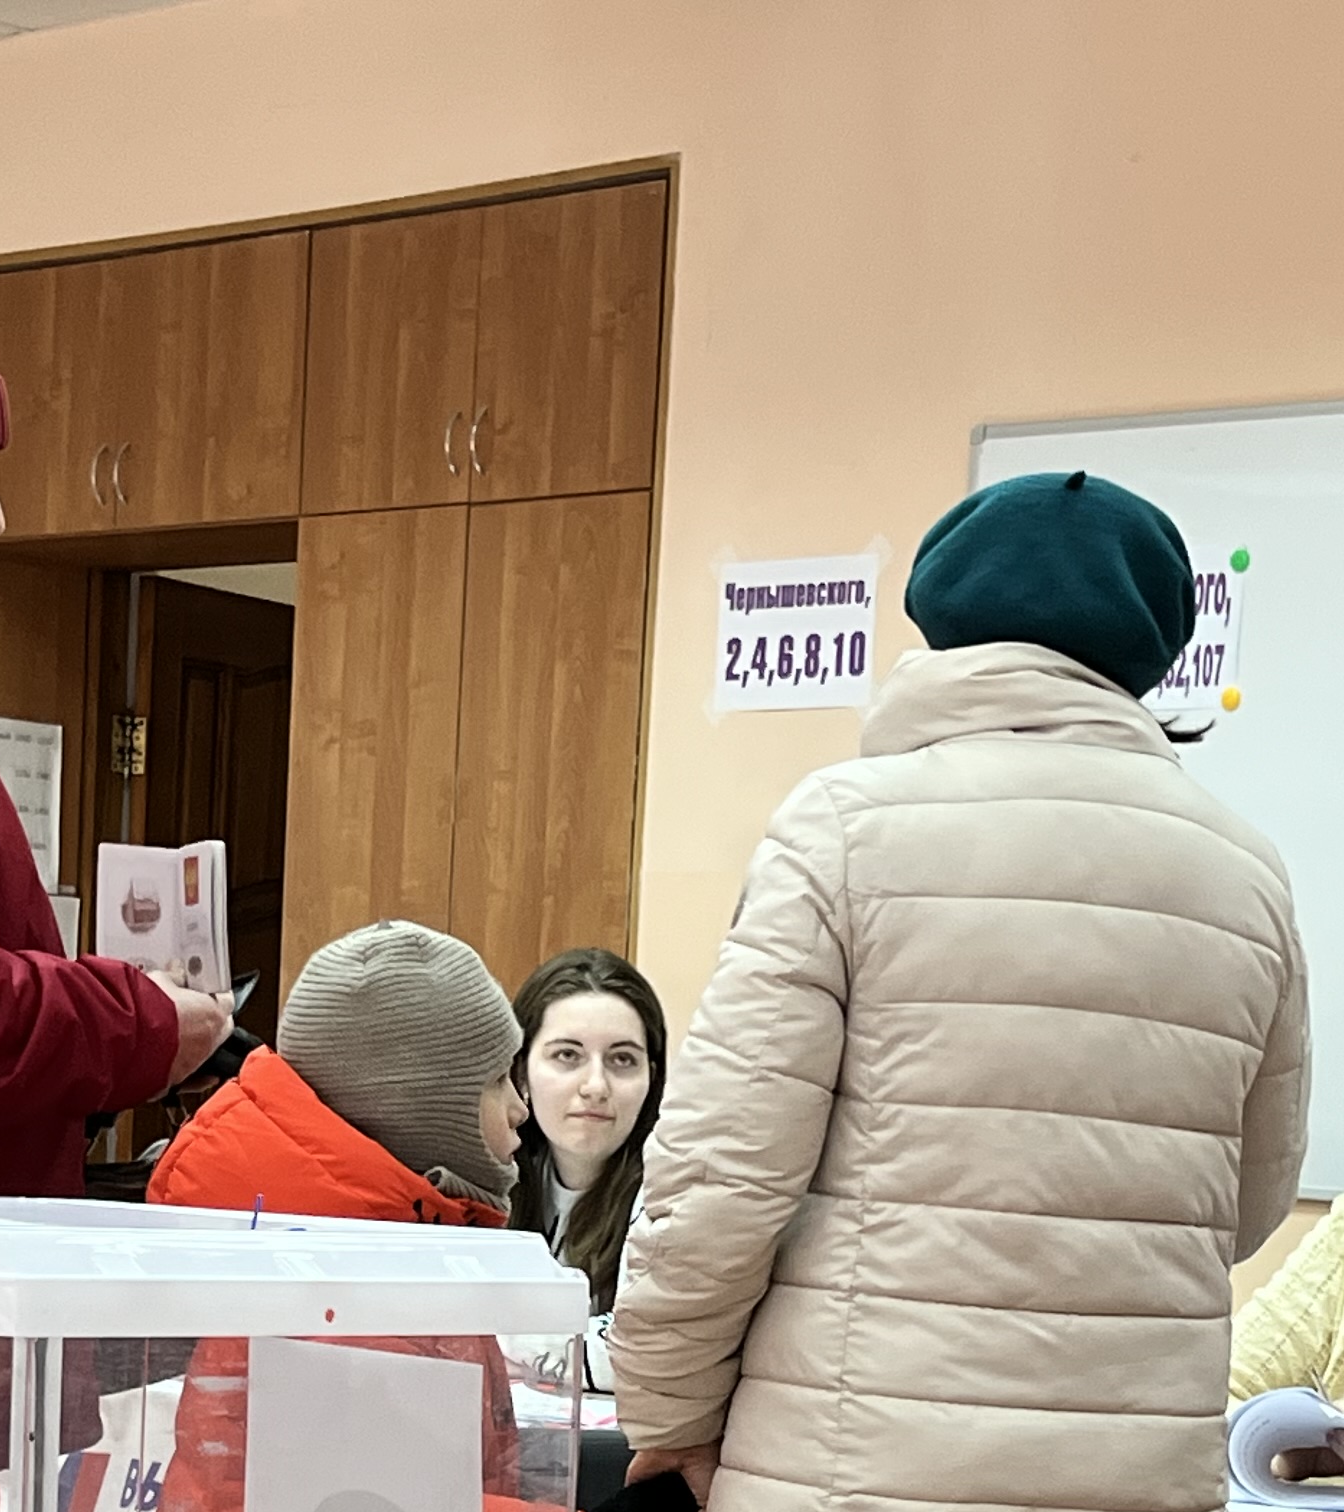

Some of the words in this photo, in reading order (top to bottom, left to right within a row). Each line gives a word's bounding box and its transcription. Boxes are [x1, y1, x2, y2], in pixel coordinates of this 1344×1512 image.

[724, 579, 871, 615] Чернышевского,
[1194, 571, 1232, 627] ого,
[724, 630, 867, 688] 2,4,6,8,10
